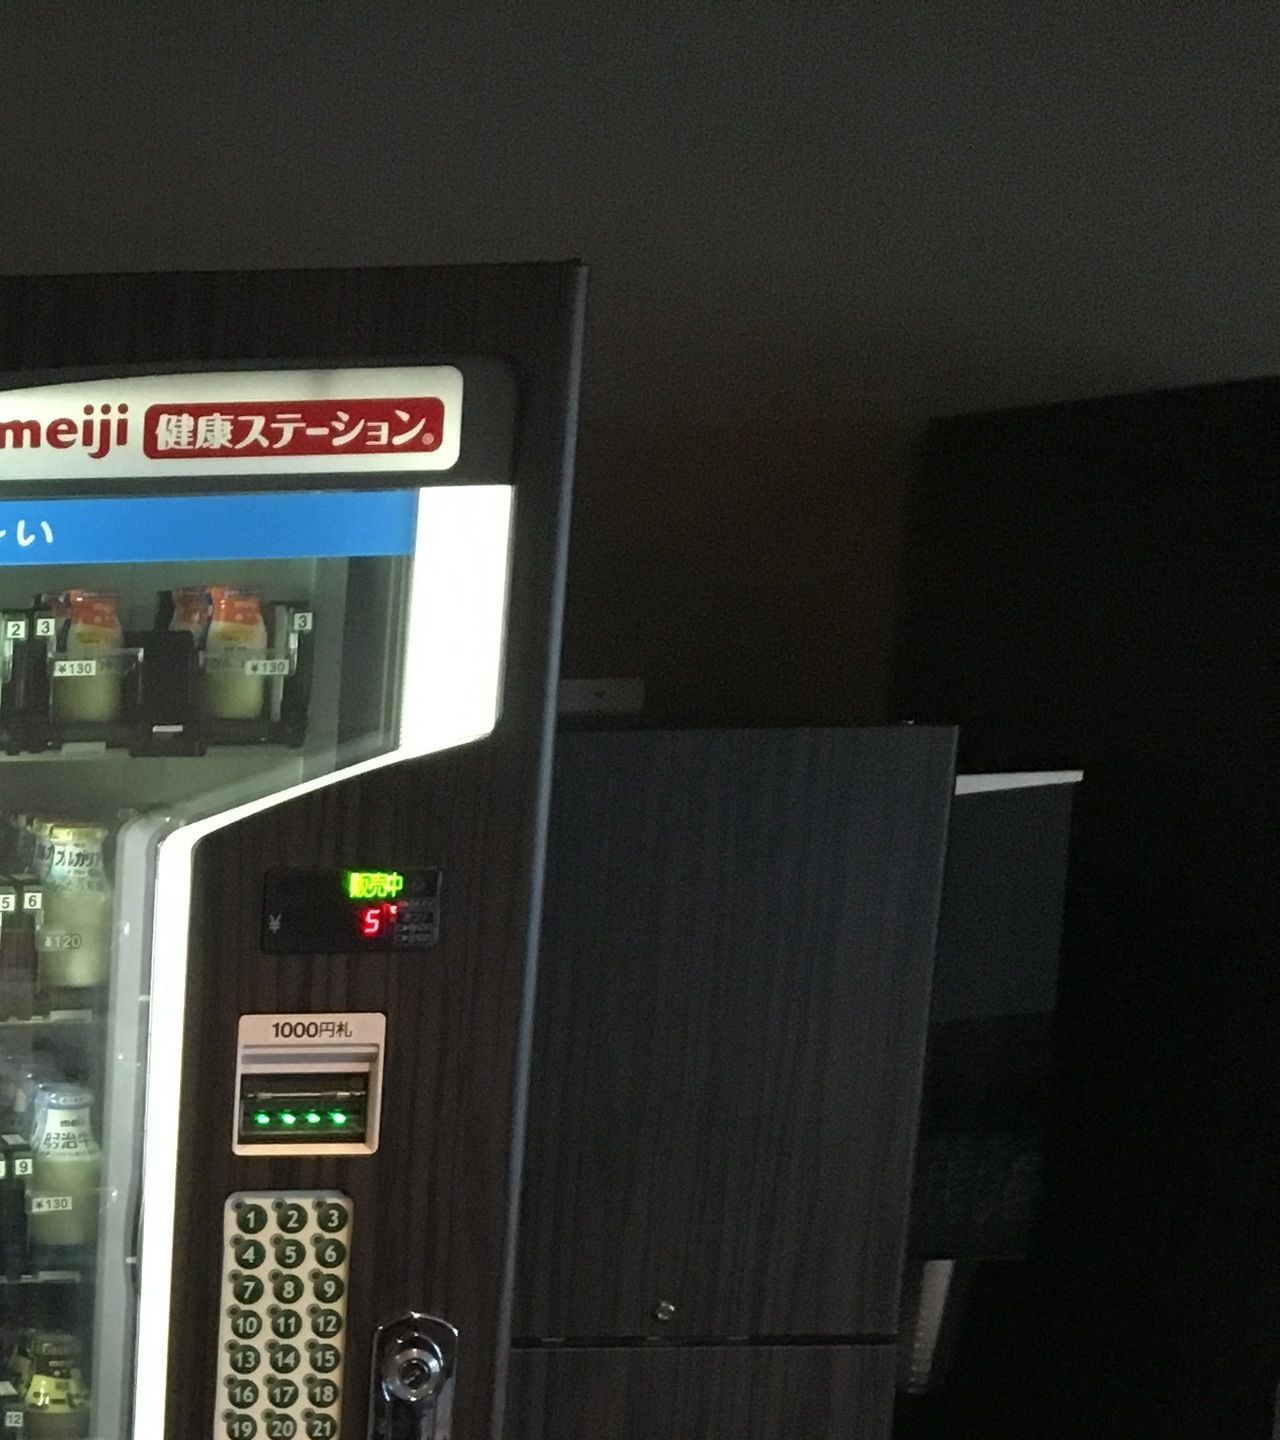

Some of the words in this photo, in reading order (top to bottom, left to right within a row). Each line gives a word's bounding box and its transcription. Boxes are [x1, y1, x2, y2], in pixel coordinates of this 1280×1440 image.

[153, 410, 428, 452] 健康ステーション
[11, 623, 21, 636] 2
[41, 620, 51, 634] 3
[298, 614, 308, 629] 3
[57, 661, 93, 676] ¥130
[1, 897, 10, 909] 5
[28, 894, 38, 907] 6
[271, 1020, 353, 1039] 1000円札
[18, 1160, 28, 1173] 9
[247, 1212, 255, 1227] 1
[288, 1211, 299, 1227] 2
[328, 1210, 339, 1226] 3
[242, 1247, 255, 1262] 4
[285, 1247, 297, 1262] 5
[325, 1246, 337, 1261] 6
[243, 1282, 254, 1298] 7
[282, 1281, 295, 1297] 8
[323, 1280, 336, 1296] 9
[238, 1317, 257, 1333] 10
[277, 1316, 297, 1332] 11
[317, 1316, 338, 1331] 12
[235, 1351, 256, 1367] 13
[275, 1351, 296, 1367] 14
[315, 1351, 336, 1366] 15
[234, 1386, 254, 1402] 16
[273, 1386, 295, 1402] 17
[313, 1386, 335, 1401] 18
[231, 1421, 253, 1437] 19
[272, 1421, 294, 1437] 20
[312, 1420, 332, 1436] 21
